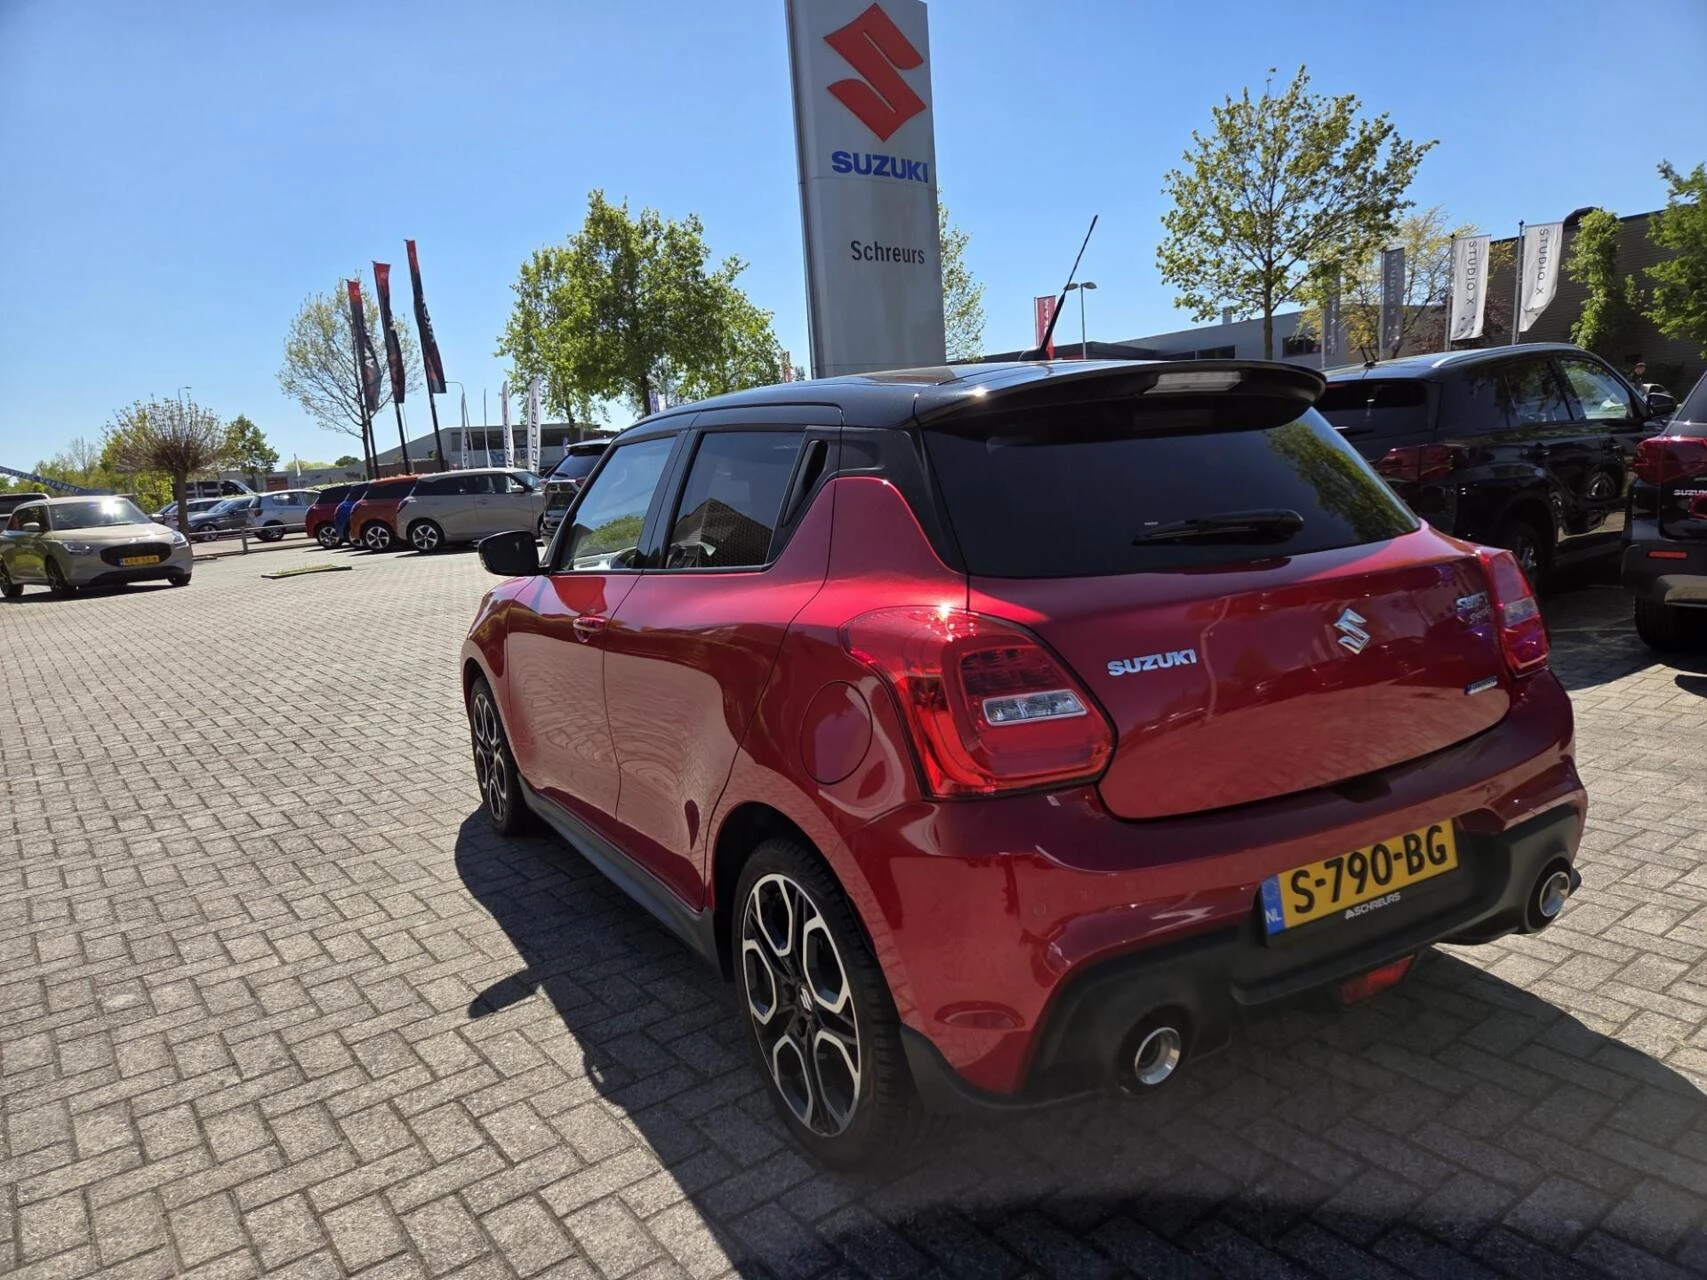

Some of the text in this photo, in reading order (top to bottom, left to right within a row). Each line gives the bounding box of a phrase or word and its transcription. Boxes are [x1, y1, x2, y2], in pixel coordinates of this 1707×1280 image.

[831, 150, 929, 183] SUZUKI
[850, 240, 926, 265] Schreurs
[1535, 228, 1549, 295] STUDIO X
[1466, 241, 1478, 305] STUDIO X
[1107, 648, 1197, 677] SUZUKI
[1291, 825, 1448, 914] S-790-BG
[1265, 908, 1282, 924] NL
